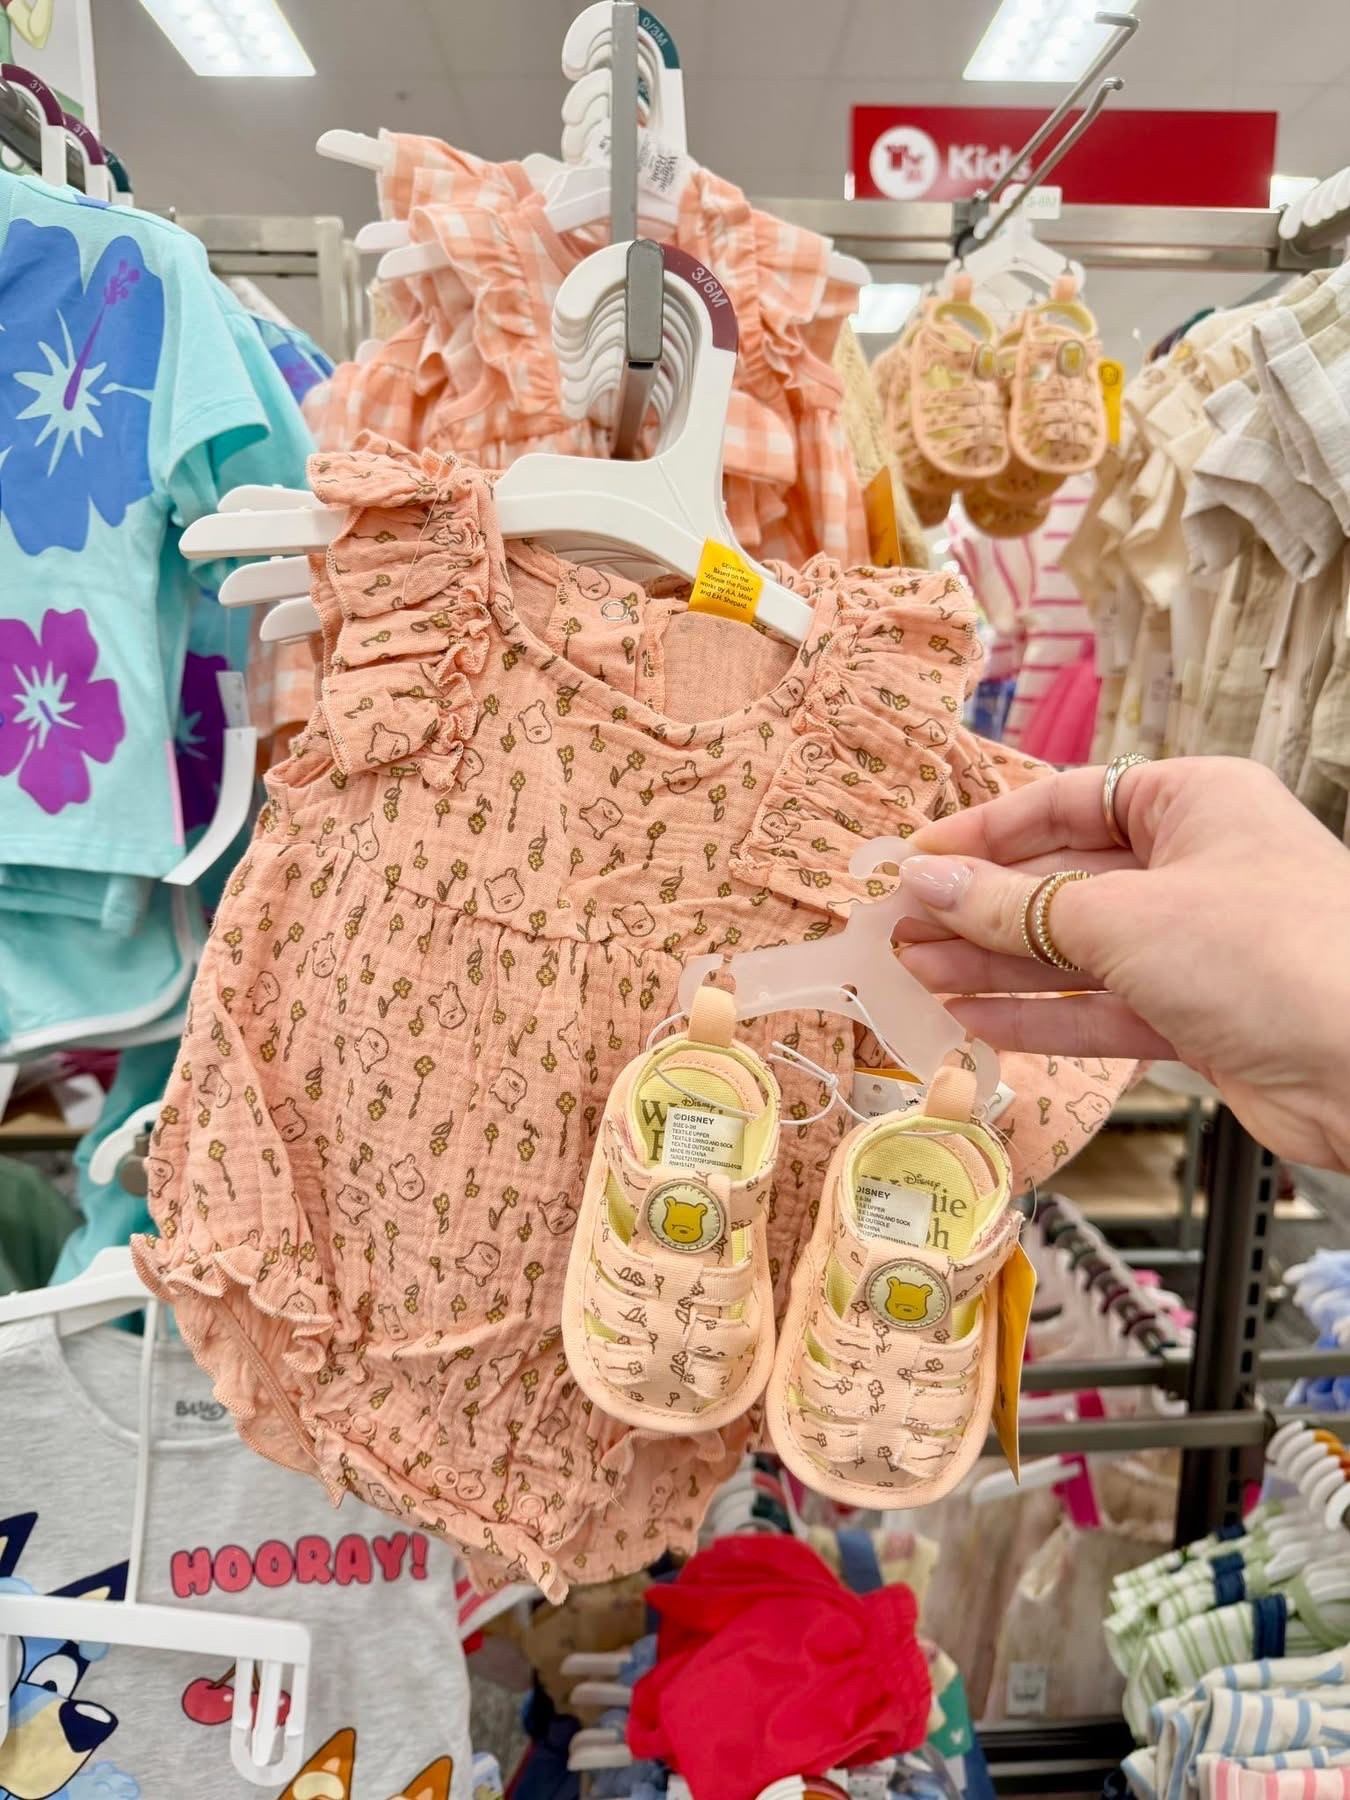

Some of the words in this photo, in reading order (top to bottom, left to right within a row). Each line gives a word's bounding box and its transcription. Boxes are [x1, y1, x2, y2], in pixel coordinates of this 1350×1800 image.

[30, 79, 46, 94] 3T
[73, 123, 89, 137] 3T
[691, 266, 729, 309] 3/6M
[713, 567, 731, 579] Based
[740, 575, 750, 584] the
[726, 579, 737, 588] the
[699, 589, 712, 598] and
[700, 581, 717, 591] works
[717, 585, 726, 594] by
[737, 592, 754, 603] Milne
[671, 1128, 692, 1136] TEXTILE
[692, 1130, 710, 1139] UPPER
[671, 1134, 692, 1143] TEXTILE
[692, 1137, 709, 1146] LINING
[709, 1139, 720, 1147] AND
[671, 1141, 692, 1149] TEXTILE
[692, 1143, 716, 1153] OUTSOLE
[670, 1147, 685, 1155] MADE
[691, 1150, 707, 1158] CHINA
[901, 1169, 942, 1192] Disney
[885, 1215, 896, 1223] AND
[896, 1218, 911, 1227] SOCK
[170, 1530, 430, 1599] HOORAY!
